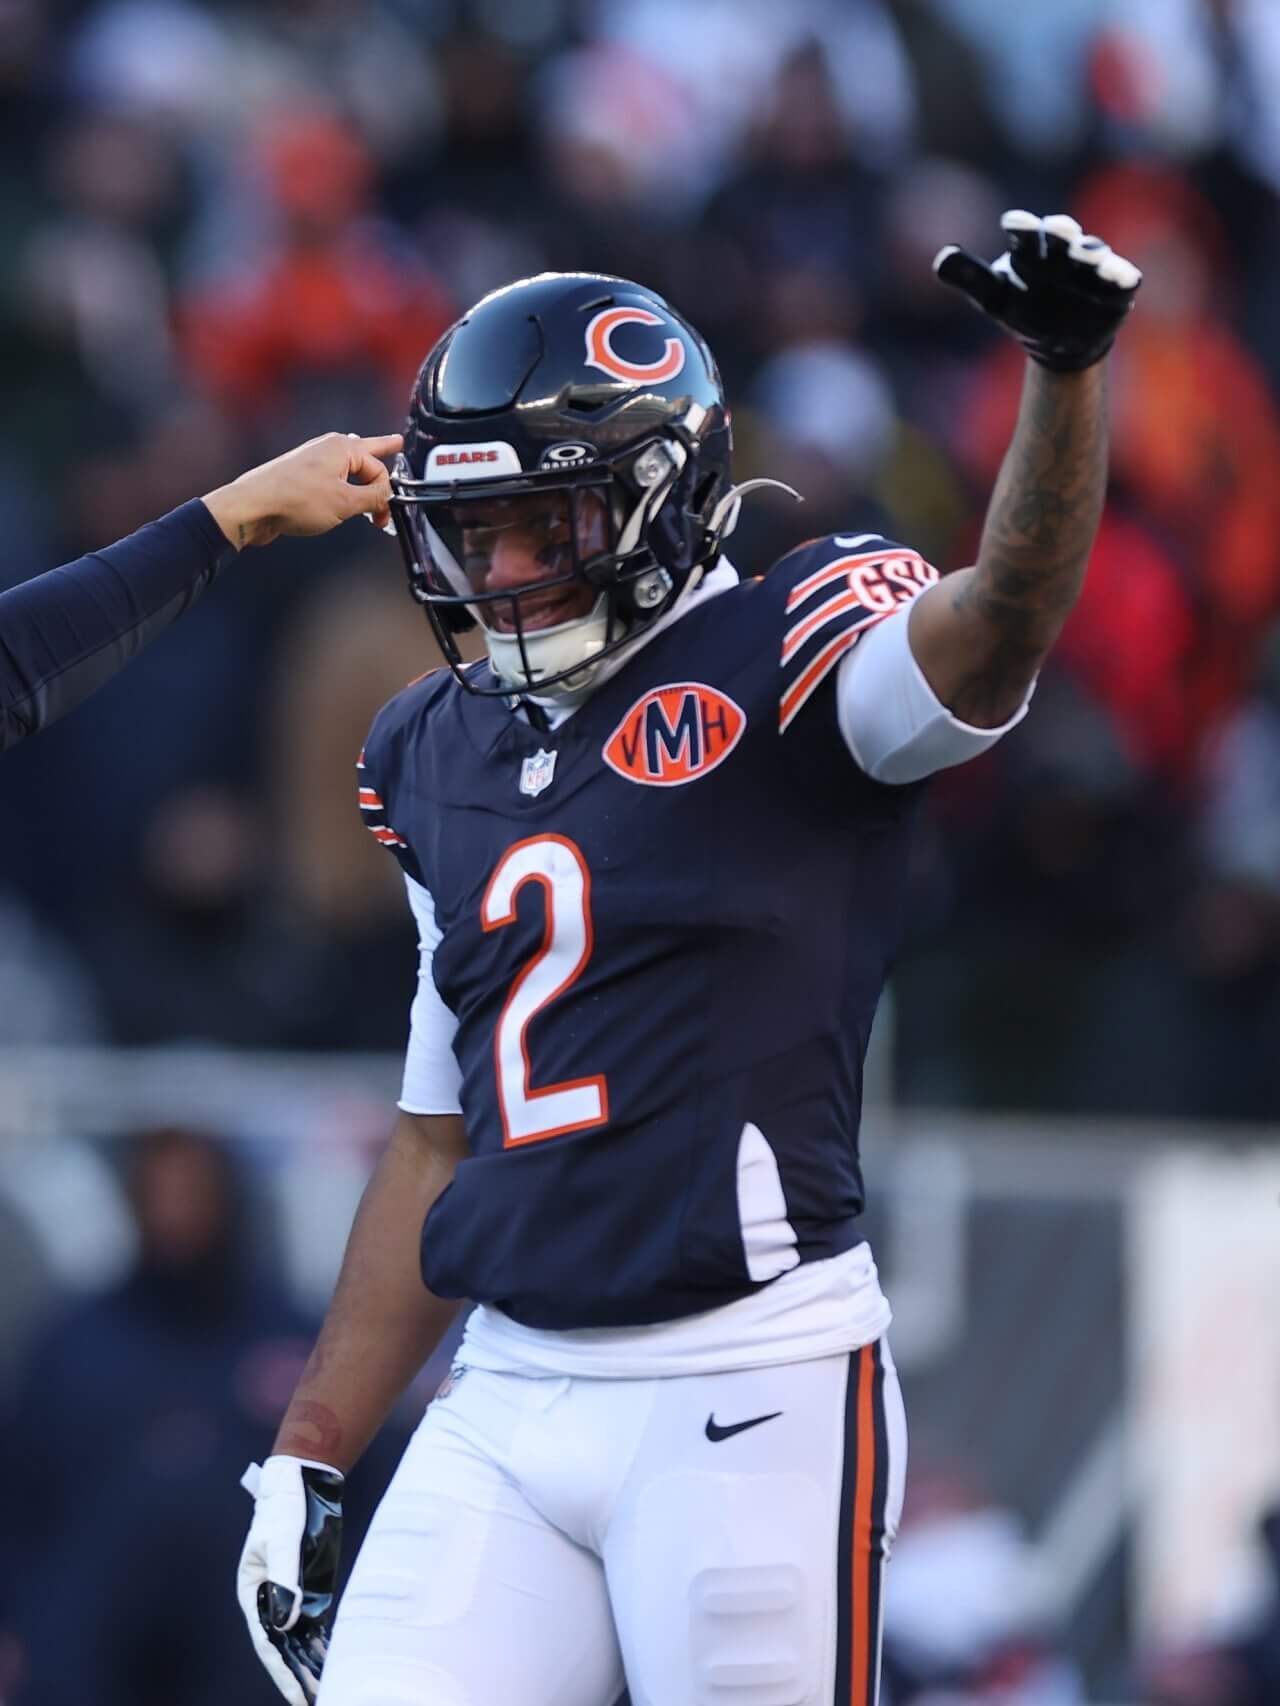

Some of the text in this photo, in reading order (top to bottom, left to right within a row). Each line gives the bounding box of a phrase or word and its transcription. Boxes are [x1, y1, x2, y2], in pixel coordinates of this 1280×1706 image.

[584, 306, 685, 385] C
[436, 450, 498, 466] BEARS
[480, 832, 609, 1149] 2
